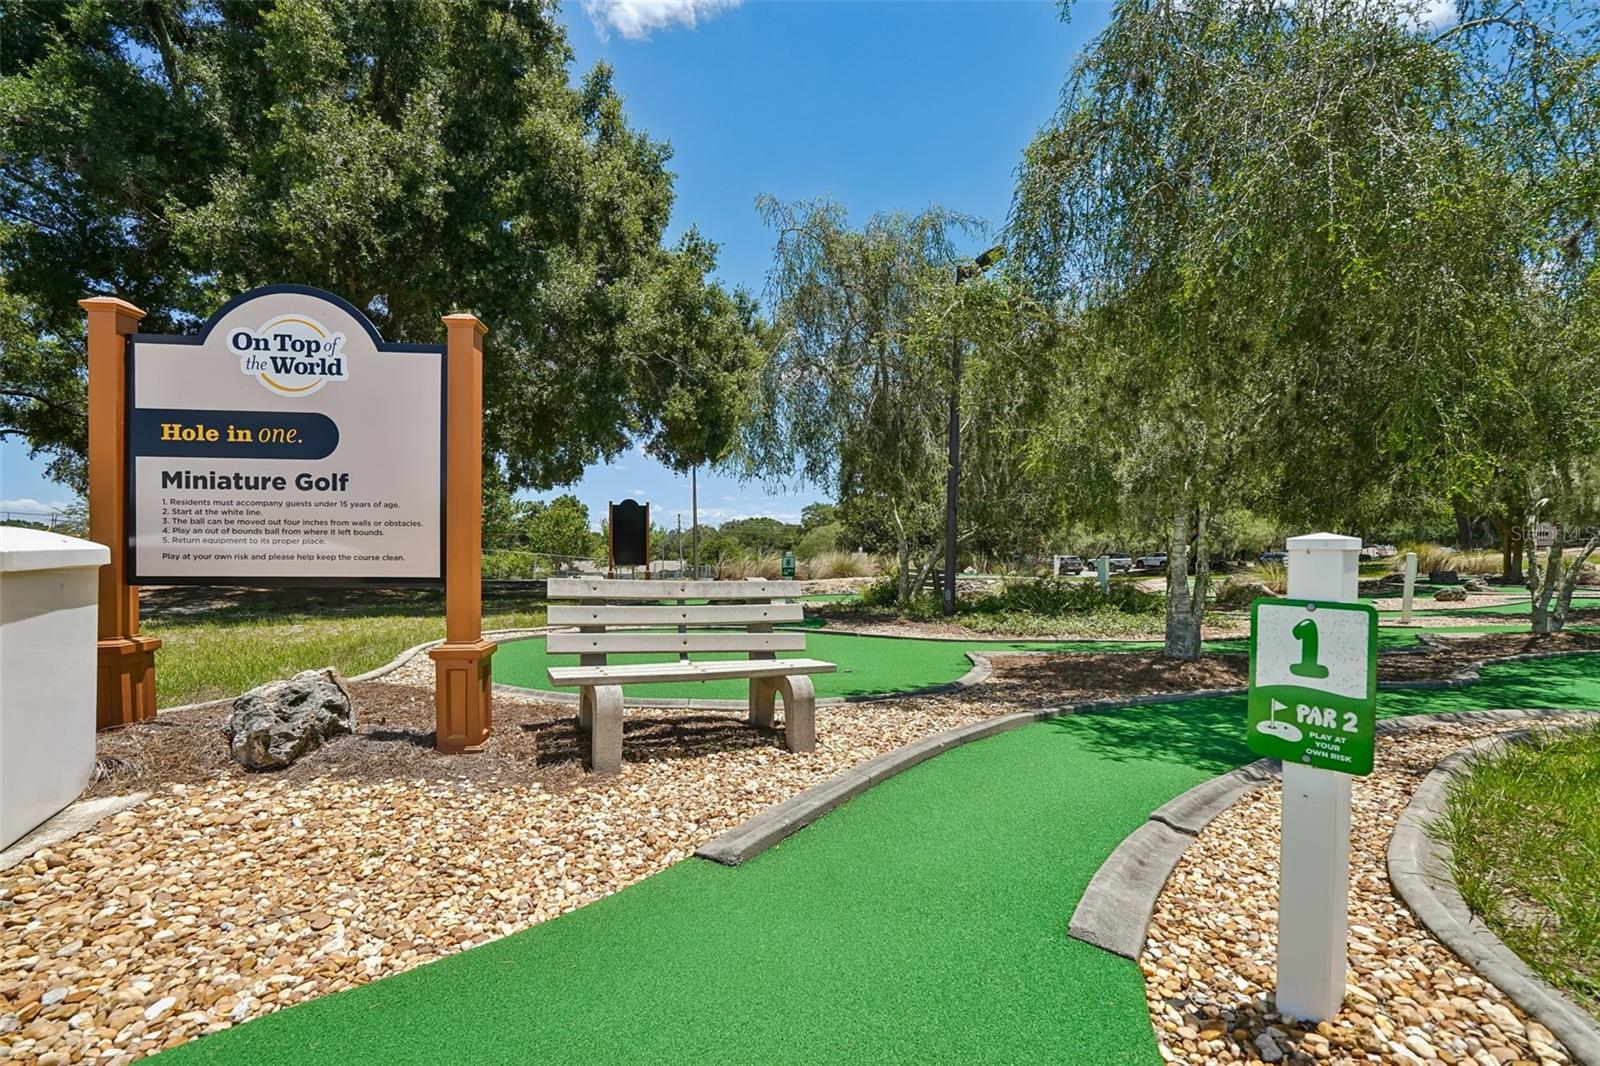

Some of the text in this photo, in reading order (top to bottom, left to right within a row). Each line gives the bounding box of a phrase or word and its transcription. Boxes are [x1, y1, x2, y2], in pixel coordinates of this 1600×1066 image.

[232, 332, 341, 358] On Top of
[246, 355, 343, 376] the World
[160, 424, 303, 444] Hole in one.
[161, 471, 349, 492] Miniature Golf
[170, 498, 211, 506] Residents
[235, 500, 283, 508] accompany
[162, 517, 170, 525] 3.
[172, 517, 188, 525] The
[172, 527, 190, 535] Play
[221, 527, 230, 535] of
[202, 537, 247, 545] equipment
[162, 553, 180, 561] Play
[268, 553, 295, 561] please
[1289, 618, 1329, 679] 1
[1296, 704, 1358, 733] PAR 2
[1309, 731, 1347, 744] PLAY AT
[1315, 741, 1340, 752] YOUR
[1306, 748, 1352, 763] OWN RISK
